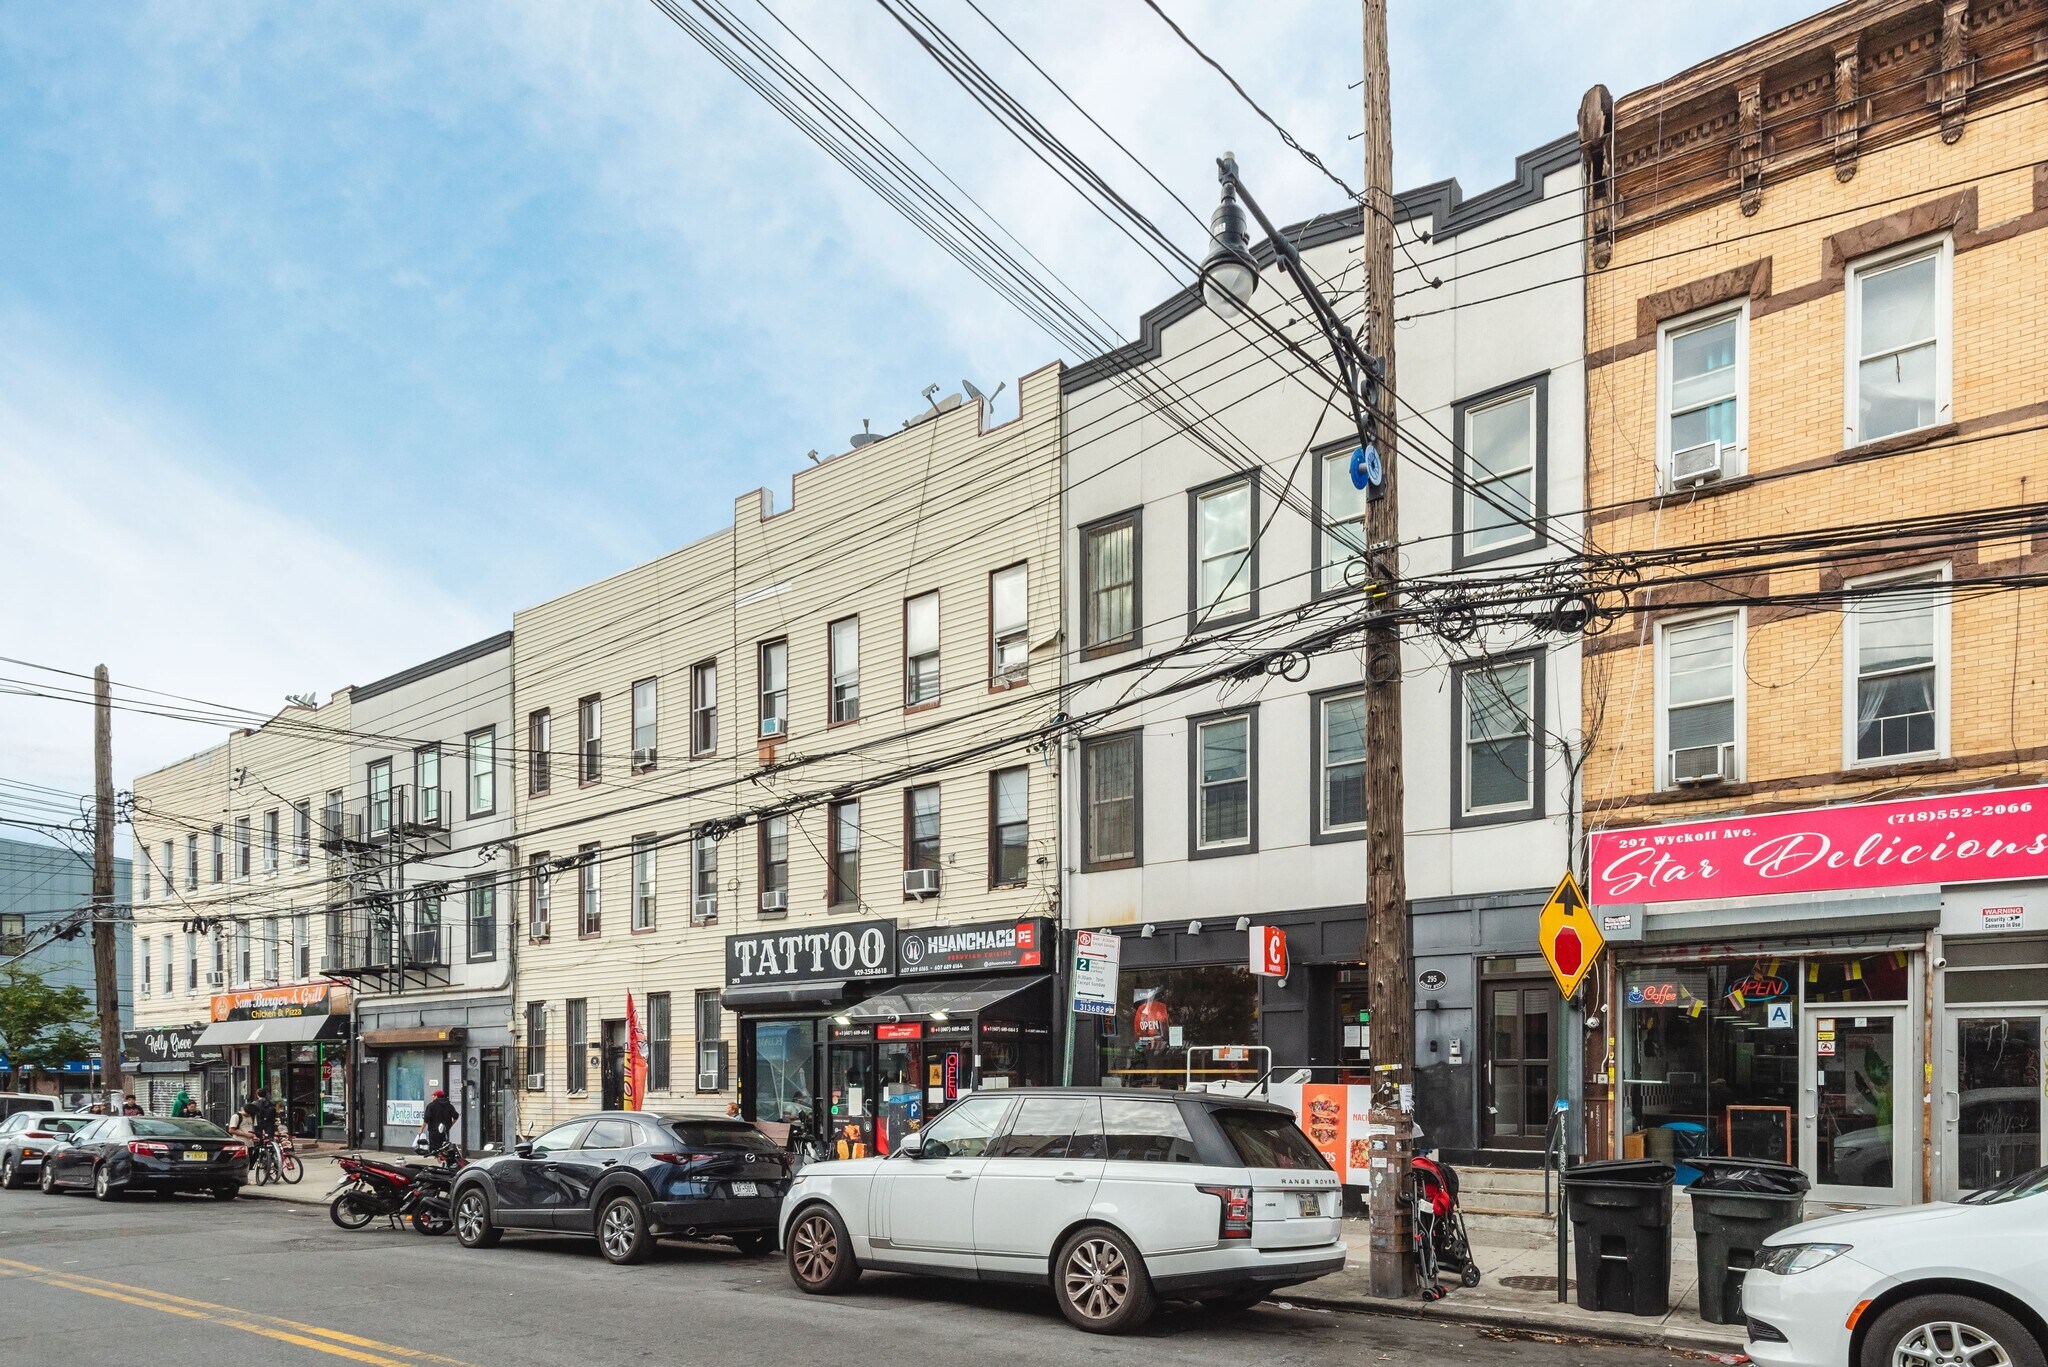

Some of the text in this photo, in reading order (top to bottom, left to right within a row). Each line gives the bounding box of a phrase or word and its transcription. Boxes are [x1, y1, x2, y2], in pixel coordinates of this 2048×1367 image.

[1887, 802, 2033, 825] (718)552-2066
[1618, 828, 1757, 849] 297 Wyckoff Ave.
[1601, 831, 2048, 896] Star Delicious
[1984, 907, 2022, 915] WARNING
[927, 928, 1031, 954] HUANCHACO PE
[734, 928, 886, 977] TATTOO
[947, 953, 982, 961] PERUVIAN
[1269, 935, 1280, 964] C
[1079, 959, 1087, 970] 2
[1427, 975, 1438, 983] 295
[1643, 984, 1678, 1005] Coffee
[1731, 980, 1784, 997] OPEN
[234, 986, 323, 1011] Sam Burger & Grill
[251, 1009, 276, 1019] Chicken
[285, 1007, 302, 1016] Pizza
[1079, 1003, 1105, 1013] 313682
[1772, 1006, 1787, 1021] A
[1140, 1020, 1159, 1030] OPEN
[170, 1032, 192, 1058] Grove
[932, 1068, 940, 1079] A
[947, 1054, 957, 1098] OPEN
[911, 1102, 918, 1117] P
[1352, 1113, 1369, 1122] NACH
